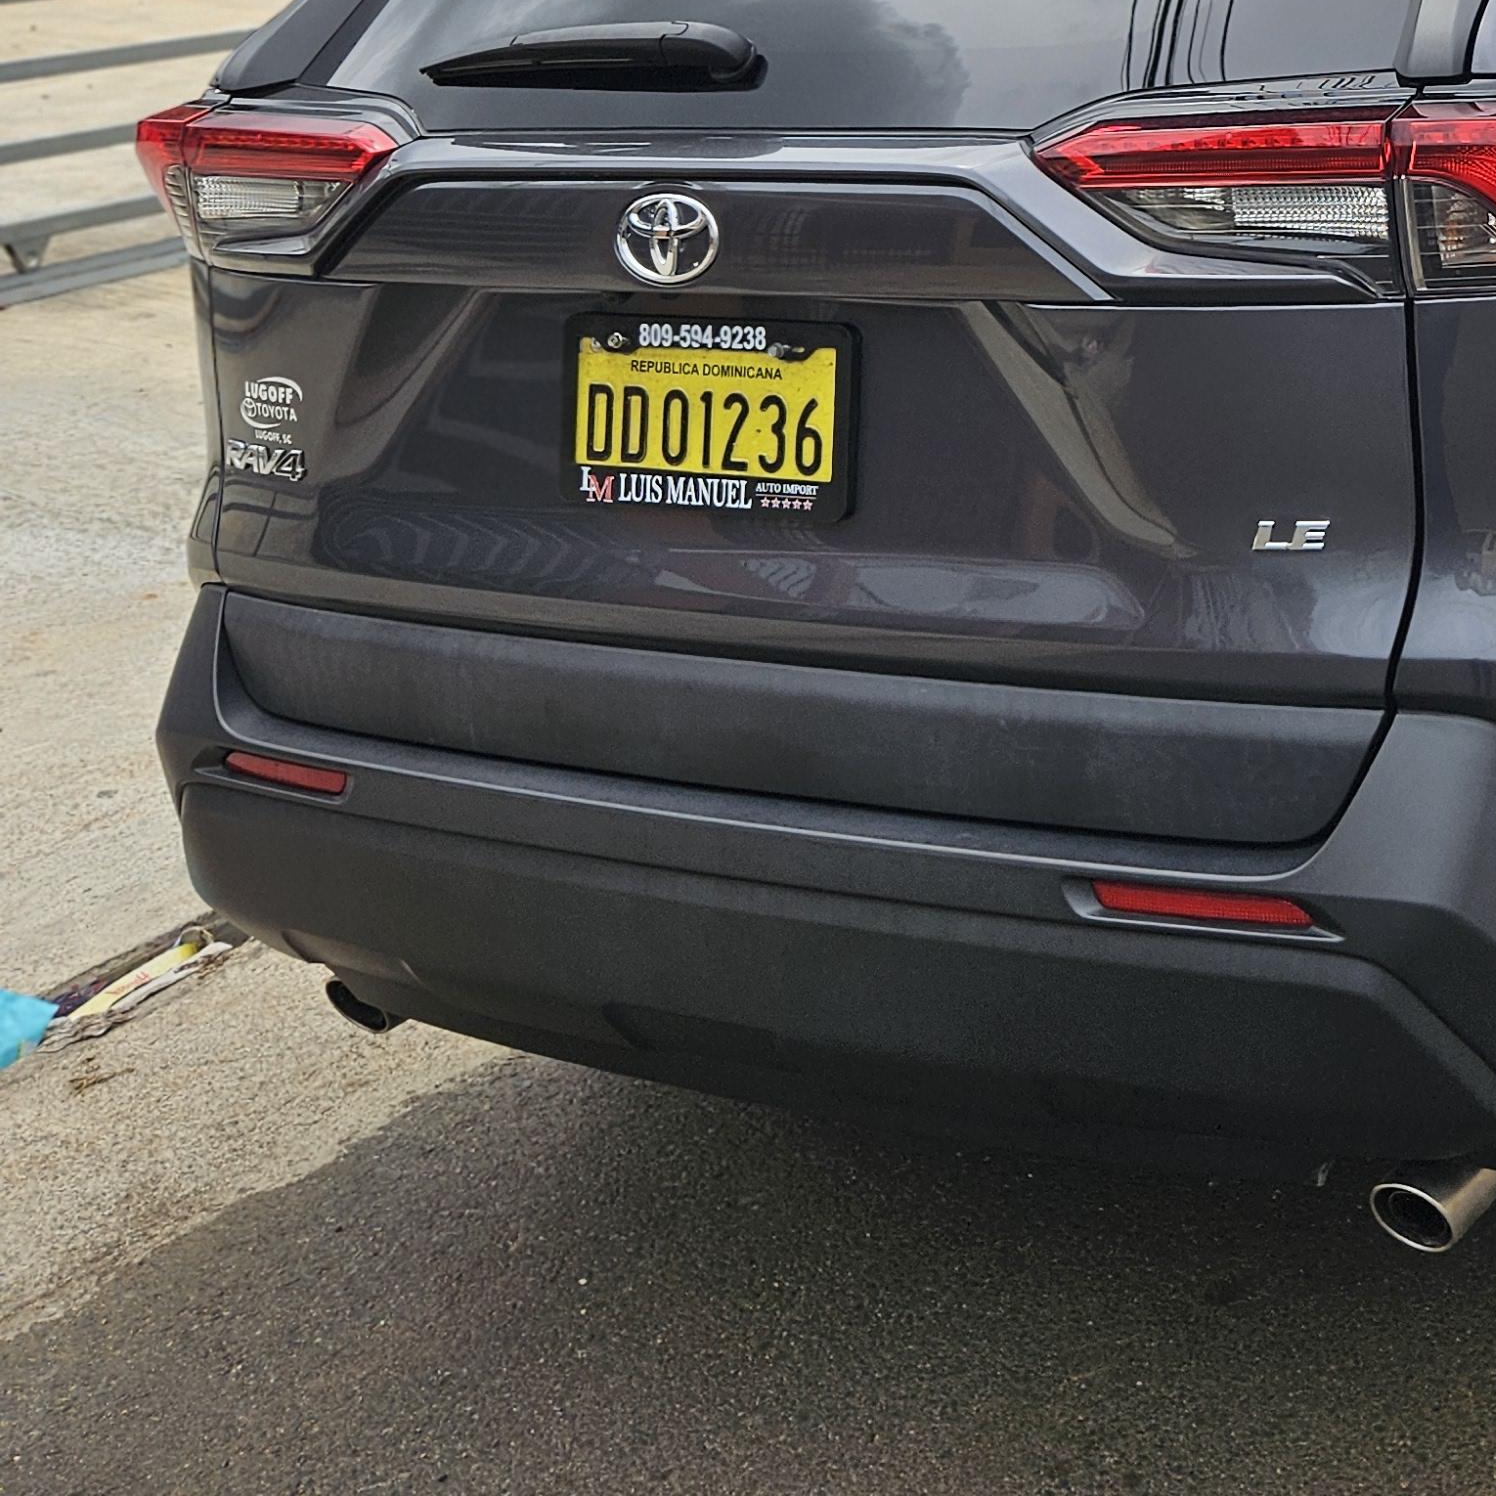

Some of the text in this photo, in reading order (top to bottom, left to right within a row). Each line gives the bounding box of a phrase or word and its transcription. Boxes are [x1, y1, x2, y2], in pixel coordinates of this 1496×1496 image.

[639, 323, 766, 350] 809-594-9238
[630, 360, 783, 380] REPUBLICA DOMINICANA
[245, 381, 293, 404] LUGOFF
[256, 403, 297, 422] TOYOTA
[586, 383, 823, 476] DD01236
[226, 439, 307, 481] RAV4
[618, 473, 662, 503] LUIS
[665, 475, 752, 509] MANUEL
[756, 482, 819, 495] AUTO IMPORT
[1252, 520, 1330, 550] LE
